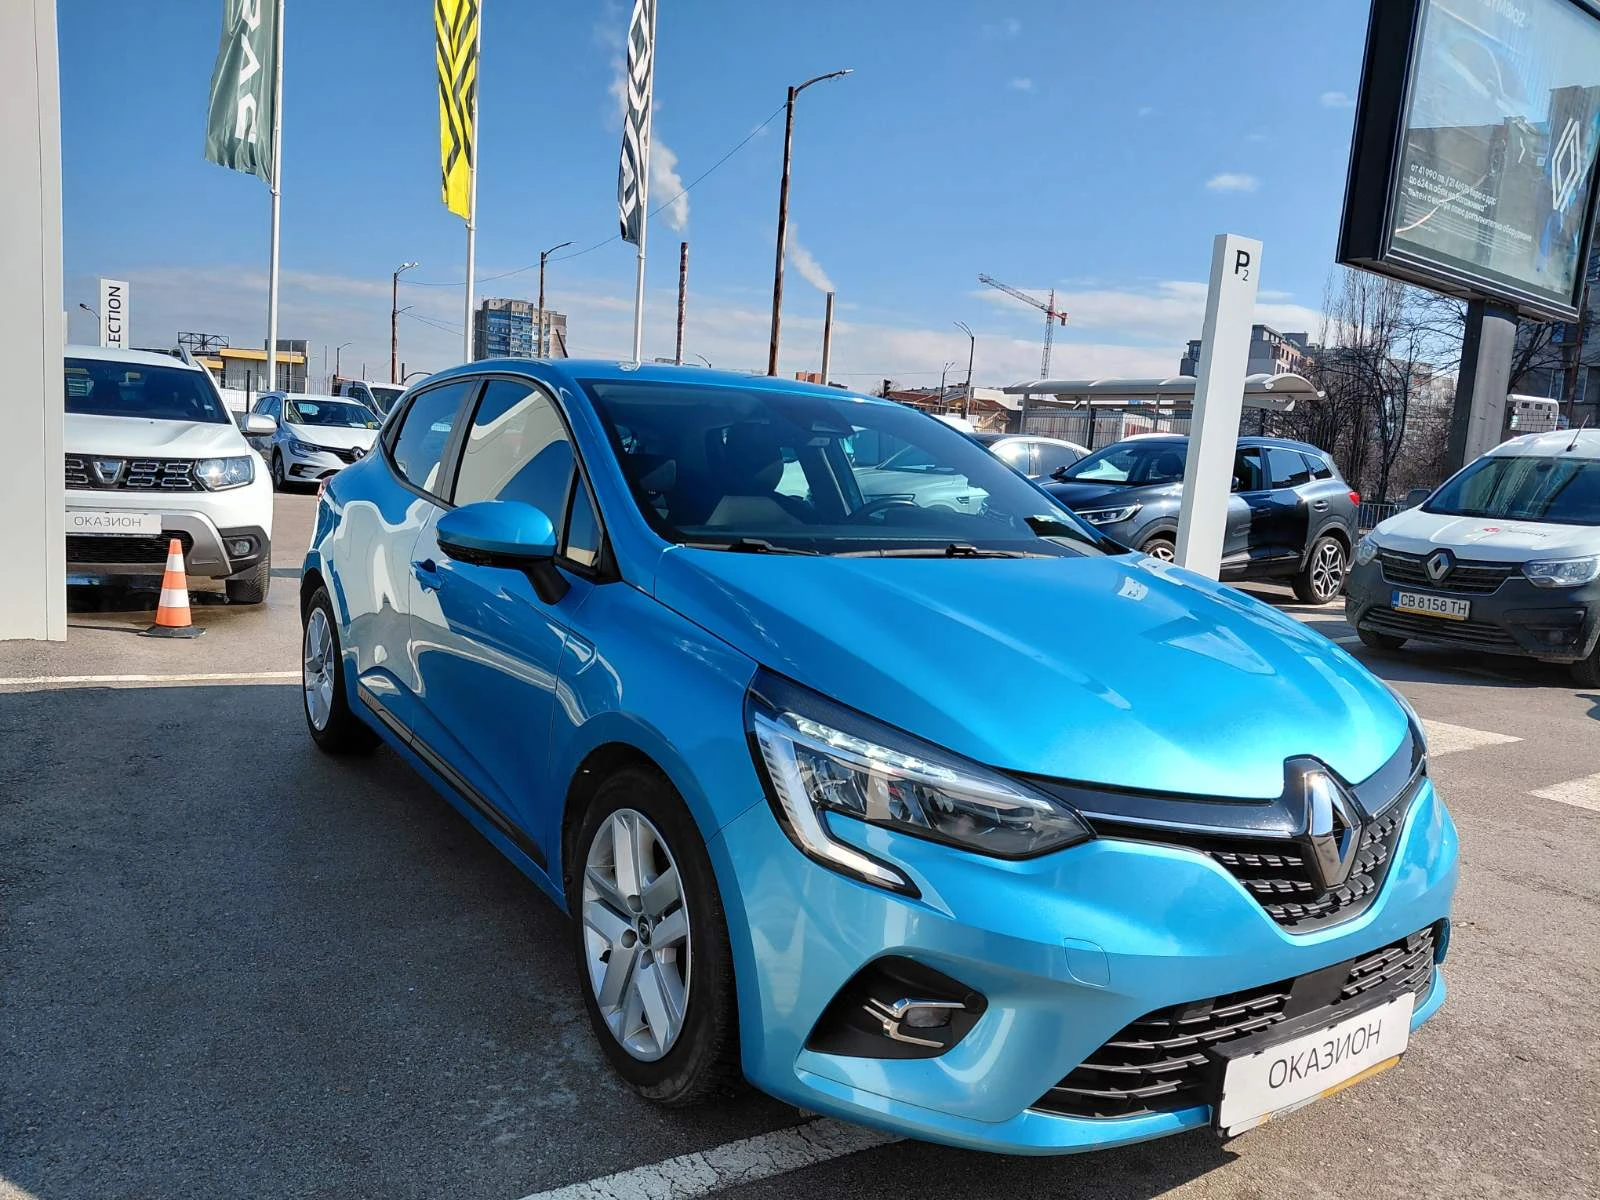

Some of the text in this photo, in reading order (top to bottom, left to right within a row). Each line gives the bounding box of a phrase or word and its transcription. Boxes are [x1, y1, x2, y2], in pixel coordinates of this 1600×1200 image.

[74, 516, 141, 527] ОКАЗИОН
[1400, 594, 1415, 606] CB
[1417, 596, 1447, 612] 8158
[1450, 600, 1467, 614] TH
[1268, 1019, 1382, 1089] ОКАЗИОН
